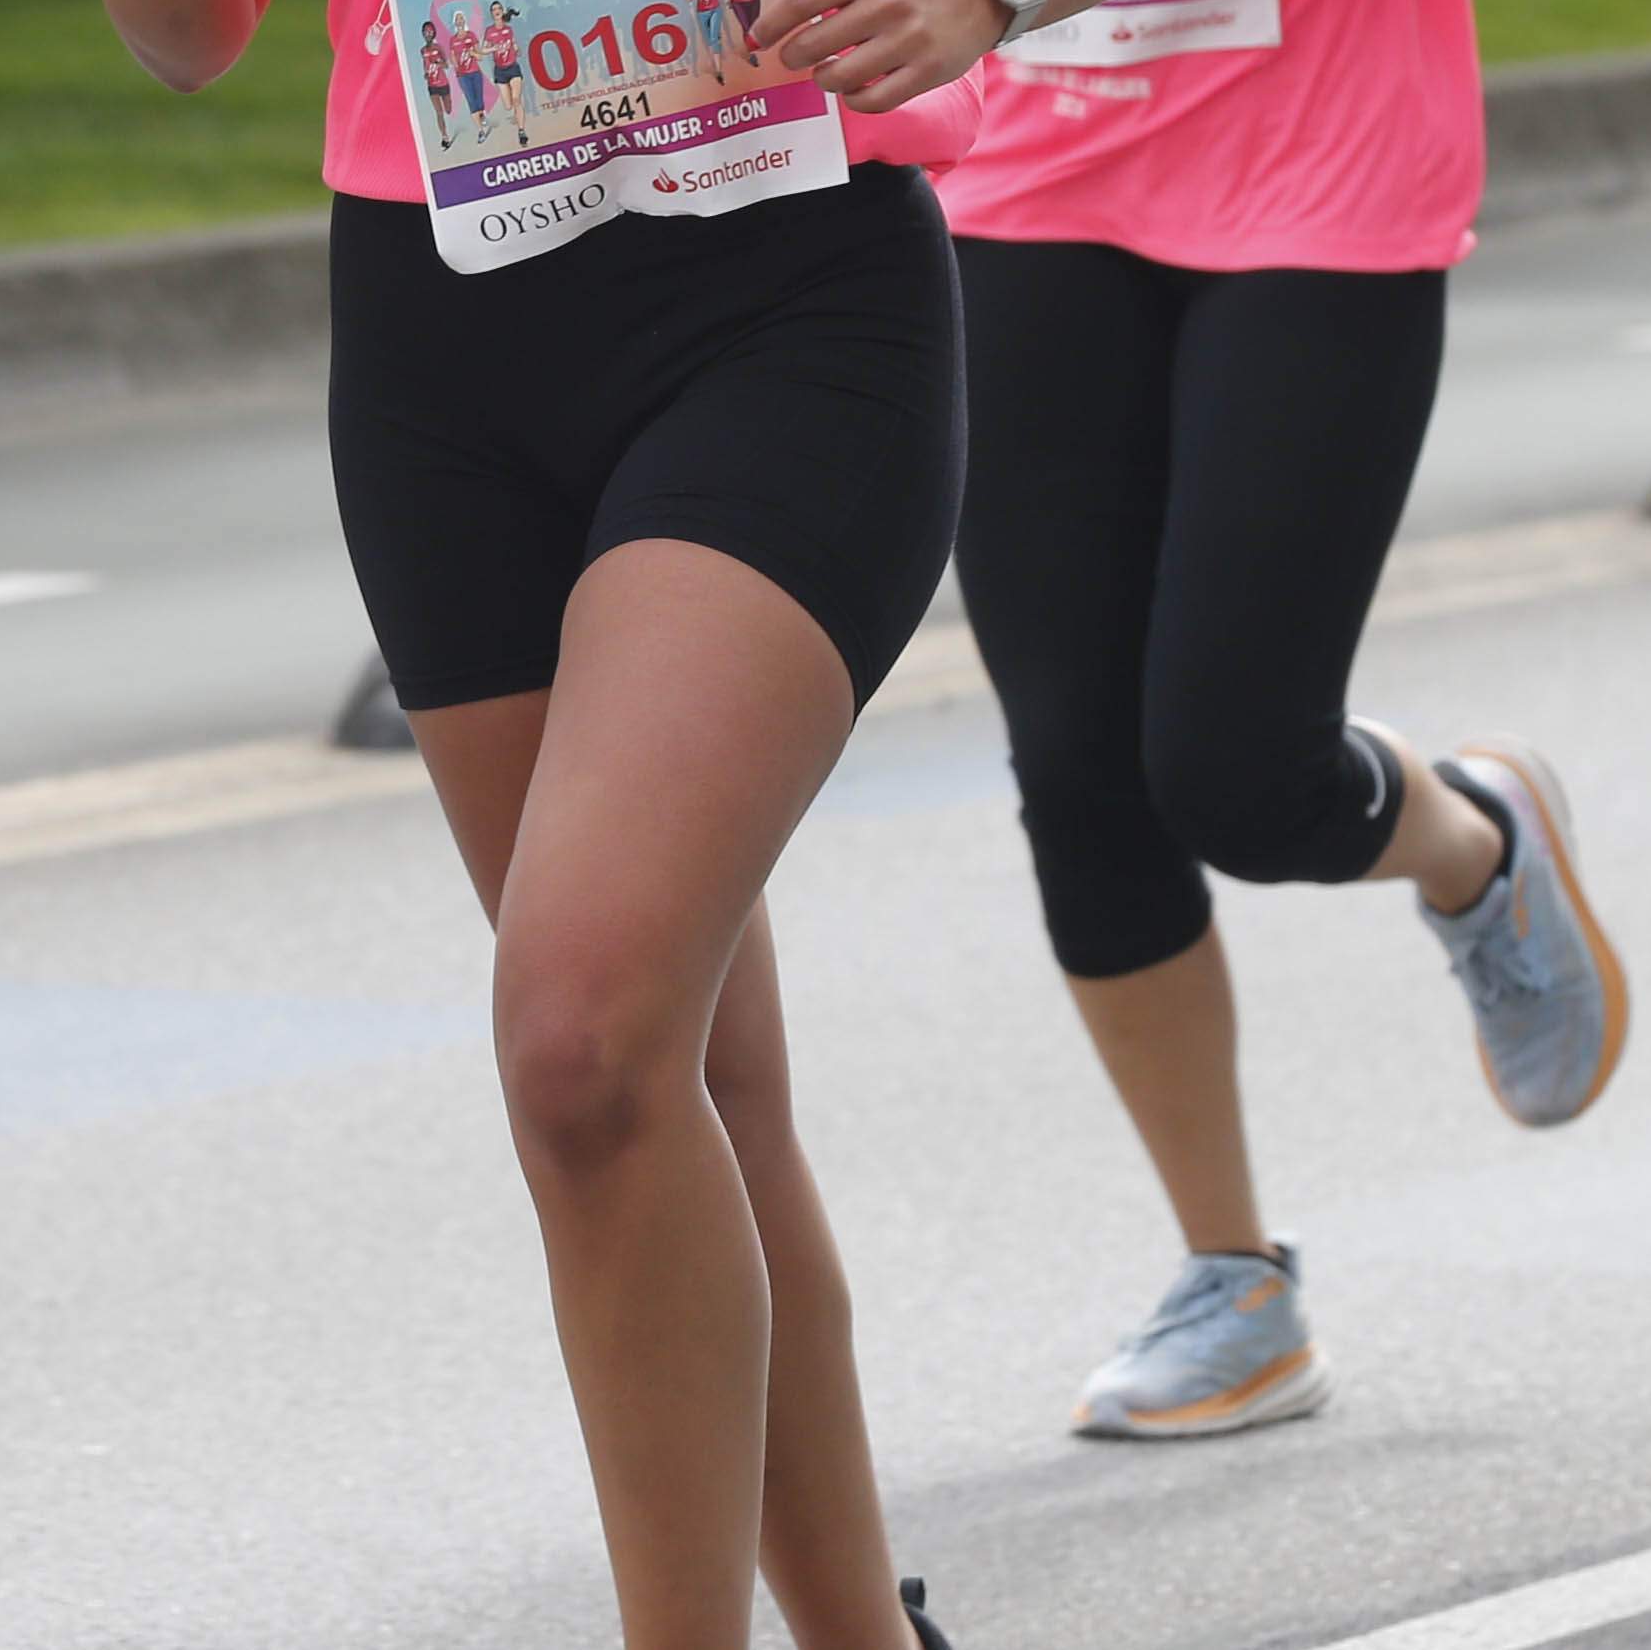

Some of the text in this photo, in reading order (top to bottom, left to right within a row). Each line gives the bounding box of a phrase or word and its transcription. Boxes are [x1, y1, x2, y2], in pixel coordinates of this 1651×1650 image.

[528, 3, 688, 91] 016
[580, 91, 651, 130] 4641
[483, 96, 767, 188] CARRERA DE LA MUJER GIJÓN
[682, 149, 793, 193] Santander
[480, 183, 605, 242] OYSHO
